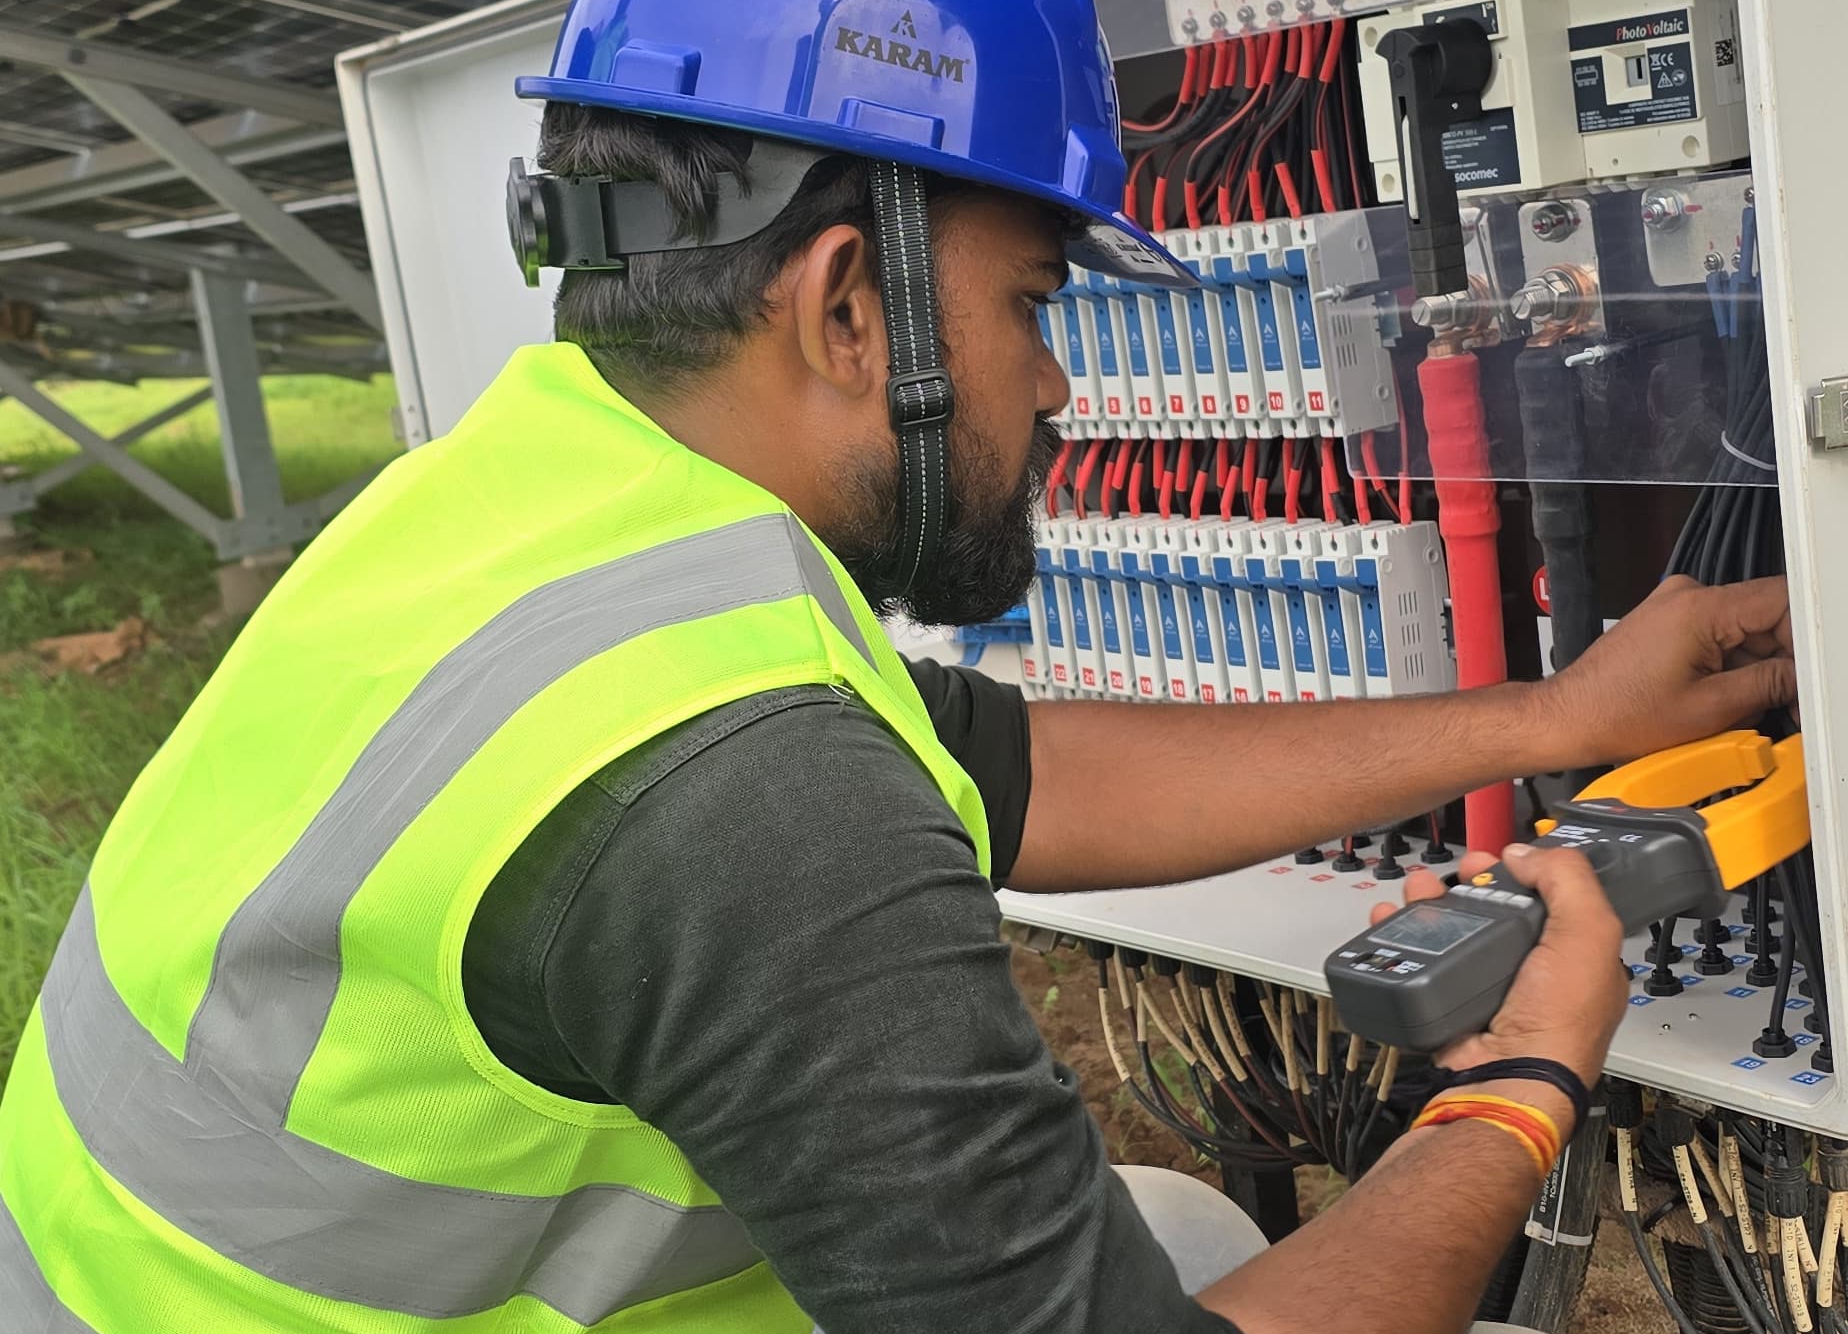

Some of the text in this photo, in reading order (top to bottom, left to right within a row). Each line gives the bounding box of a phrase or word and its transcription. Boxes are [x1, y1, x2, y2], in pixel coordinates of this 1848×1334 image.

[1616, 17, 1685, 41] PhotoVoltaic
[835, 27, 964, 83] KARAM
[1454, 168, 1499, 183] socomec
